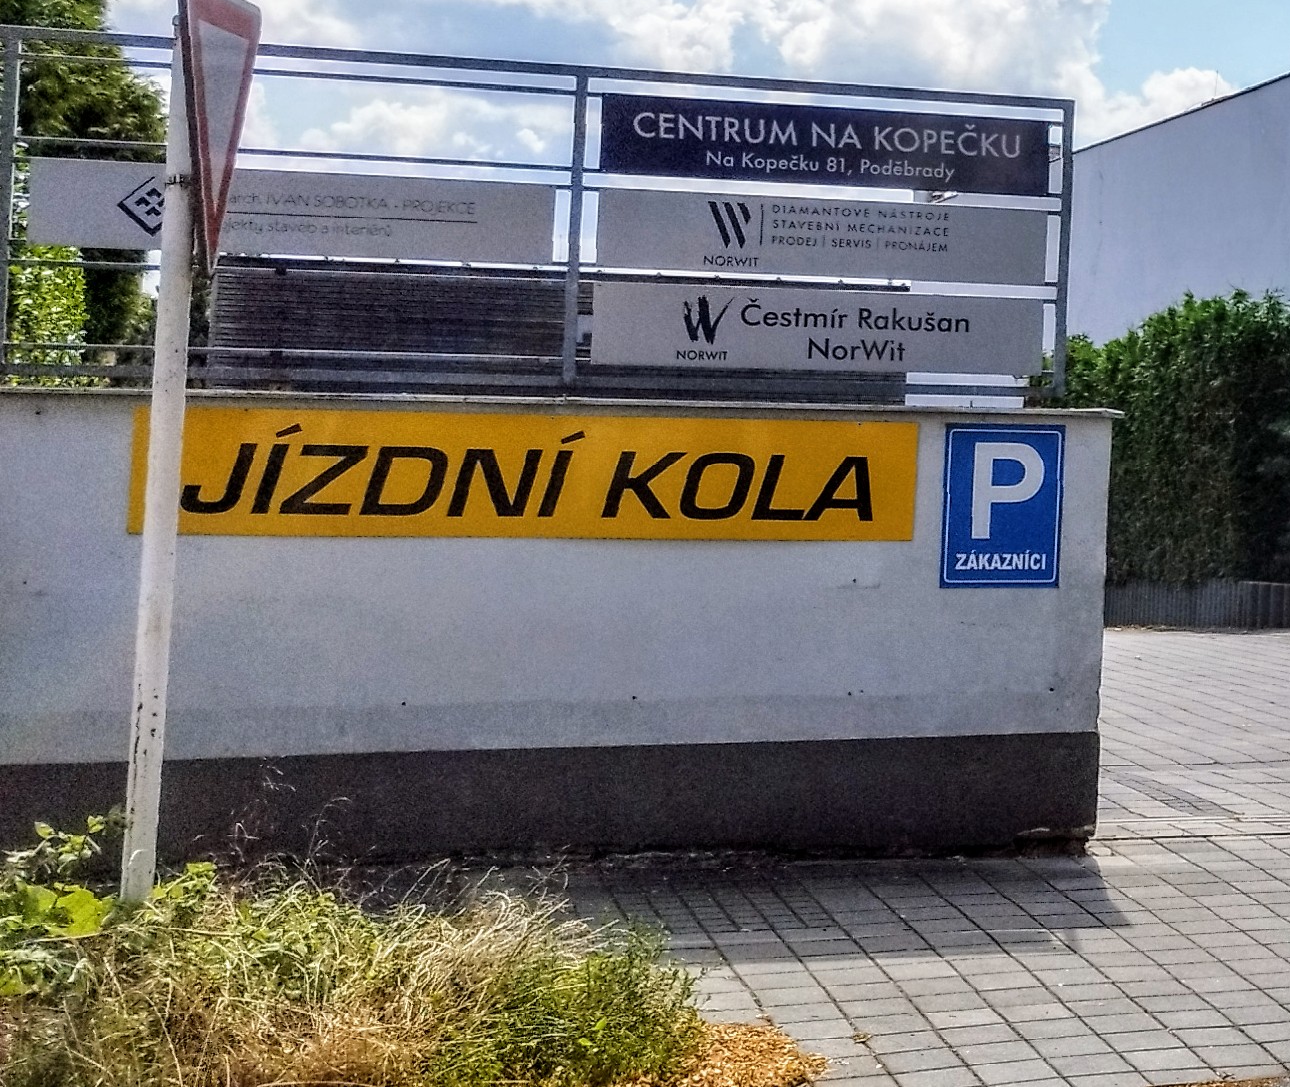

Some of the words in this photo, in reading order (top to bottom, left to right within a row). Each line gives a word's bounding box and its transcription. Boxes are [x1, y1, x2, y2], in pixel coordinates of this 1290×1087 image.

[632, 112, 798, 146] CENTRUM
[811, 121, 862, 149] NA
[874, 123, 1021, 159] KOPEČKU
[705, 150, 734, 167] Na
[741, 152, 818, 173] Kopečku
[826, 157, 852, 176] 81,
[860, 159, 955, 183] Poděbrady
[265, 194, 310, 208] IVAN
[314, 194, 388, 210] SOBOTKA
[402, 199, 475, 215] PROJEKCE
[771, 235, 818, 248] PRODEJ
[831, 237, 872, 249] SERVIS
[847, 223, 949, 237] MECHANIZACE
[703, 255, 759, 267] NORWIT
[740, 298, 848, 330] Čestmír
[858, 307, 970, 333] Rakušan
[676, 349, 728, 361] NORWIT
[807, 337, 906, 363] NorWit
[180, 423, 586, 518] JÍZDNÍ
[601, 450, 875, 523] KOLA
[971, 441, 1046, 540] P
[954, 549, 1047, 571] ZÁKAZNÍCI
